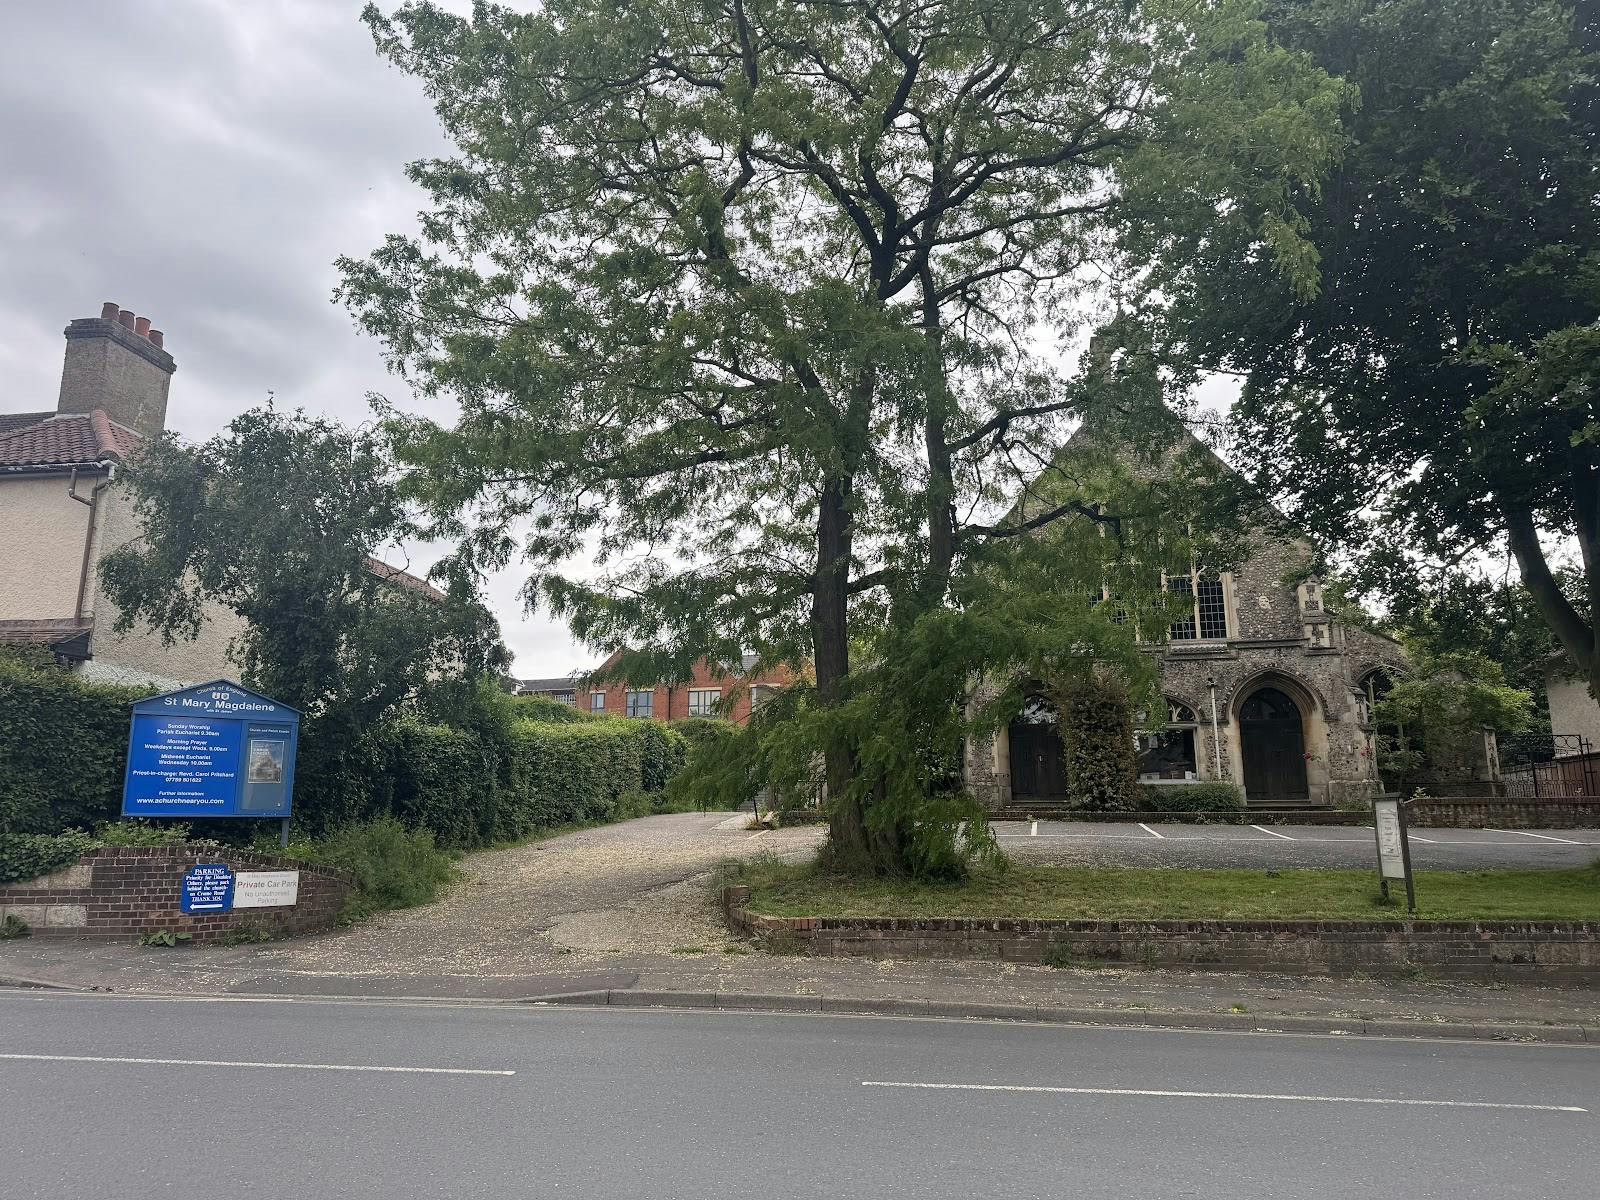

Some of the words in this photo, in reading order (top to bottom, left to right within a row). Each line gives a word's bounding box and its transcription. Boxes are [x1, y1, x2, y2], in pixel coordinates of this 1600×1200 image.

[226, 686, 247, 698] England
[164, 697, 177, 706] St
[182, 698, 211, 709] Mary
[215, 700, 275, 712] Magdalene
[137, 797, 224, 805] www.achurchnearyou.com
[237, 881, 265, 889] Private
[267, 880, 279, 888] Car
[281, 879, 297, 888] Park
